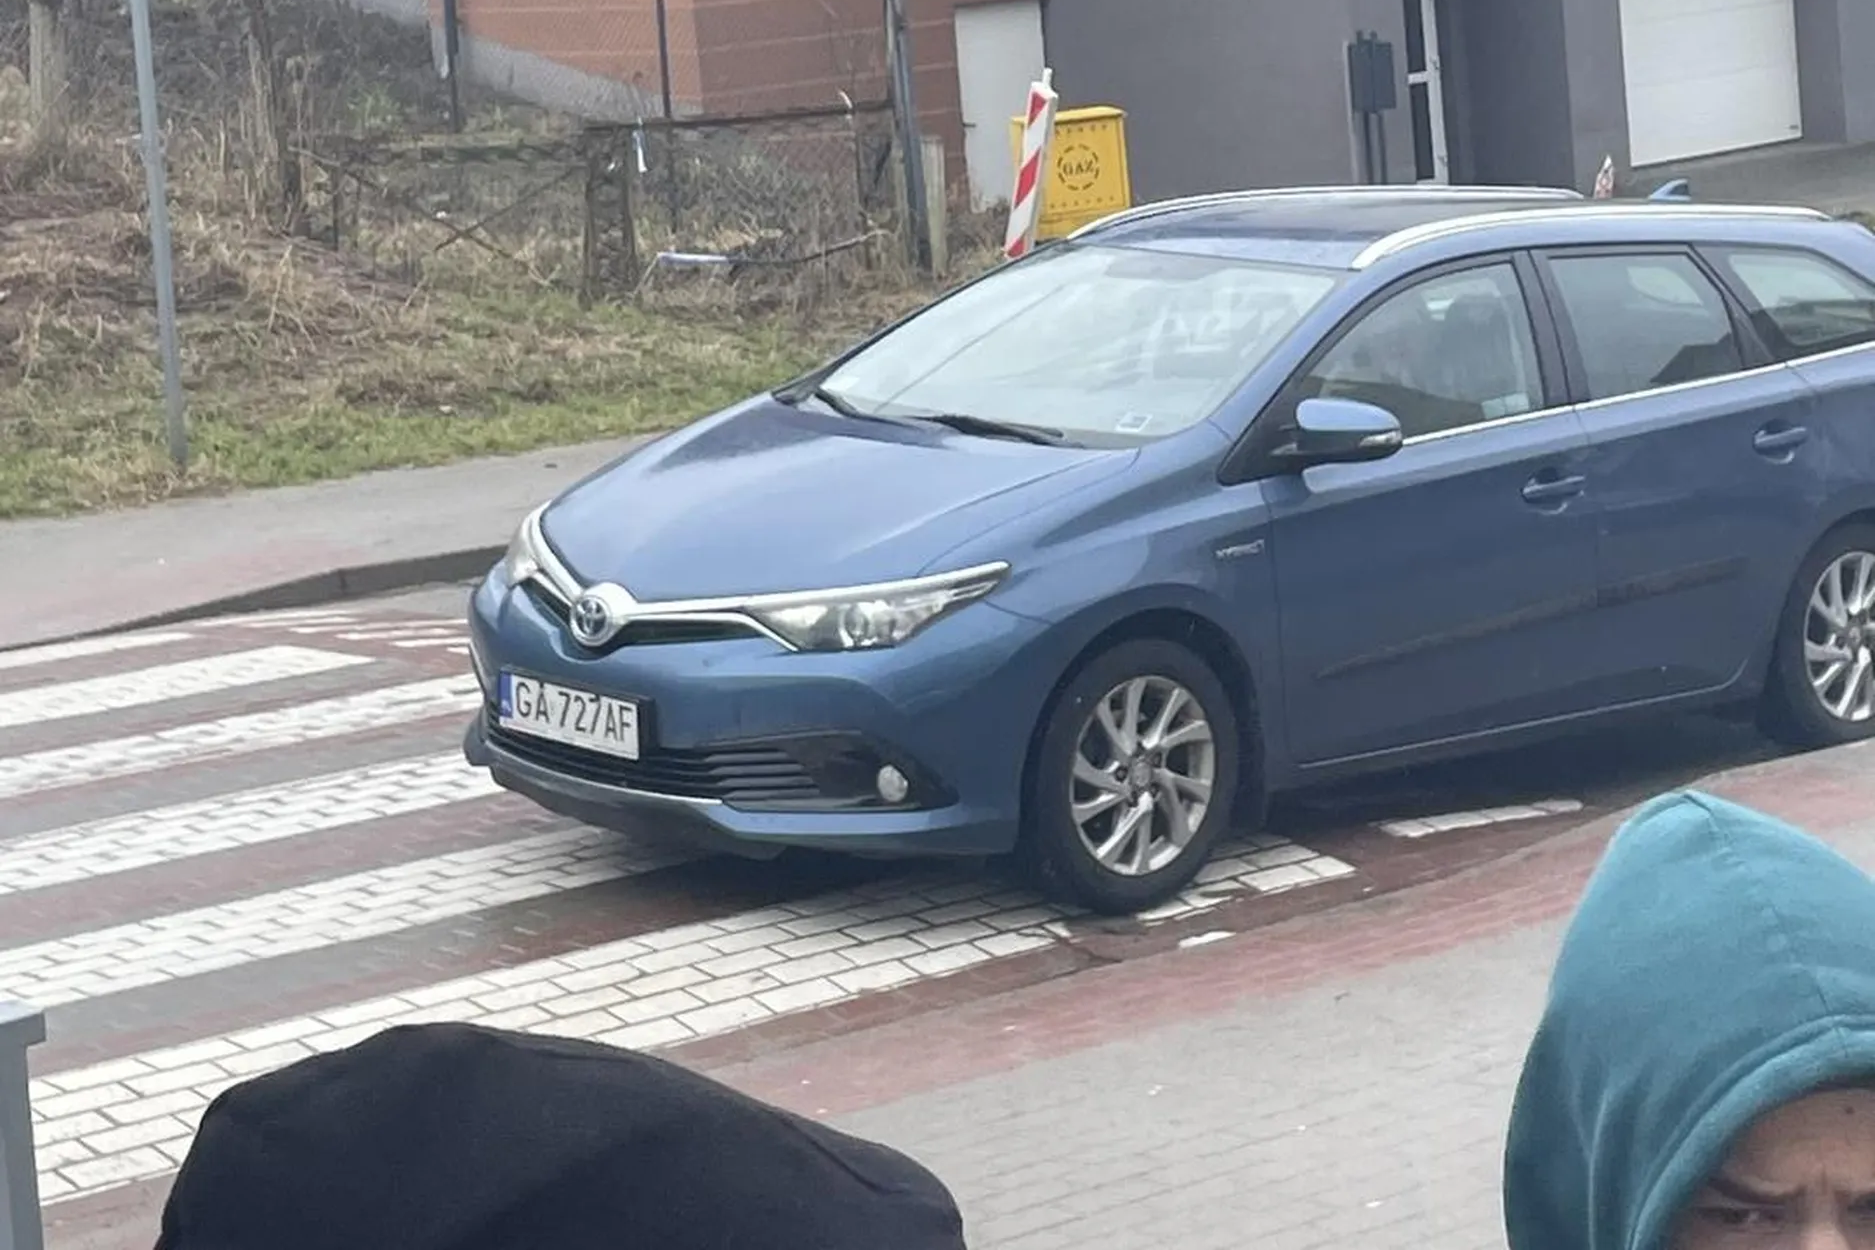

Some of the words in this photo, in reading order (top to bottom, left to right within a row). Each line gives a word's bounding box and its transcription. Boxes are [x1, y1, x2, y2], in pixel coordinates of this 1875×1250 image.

[1063, 159, 1095, 175] GAZ
[515, 681, 550, 724] GA
[557, 691, 633, 743] 727AF
